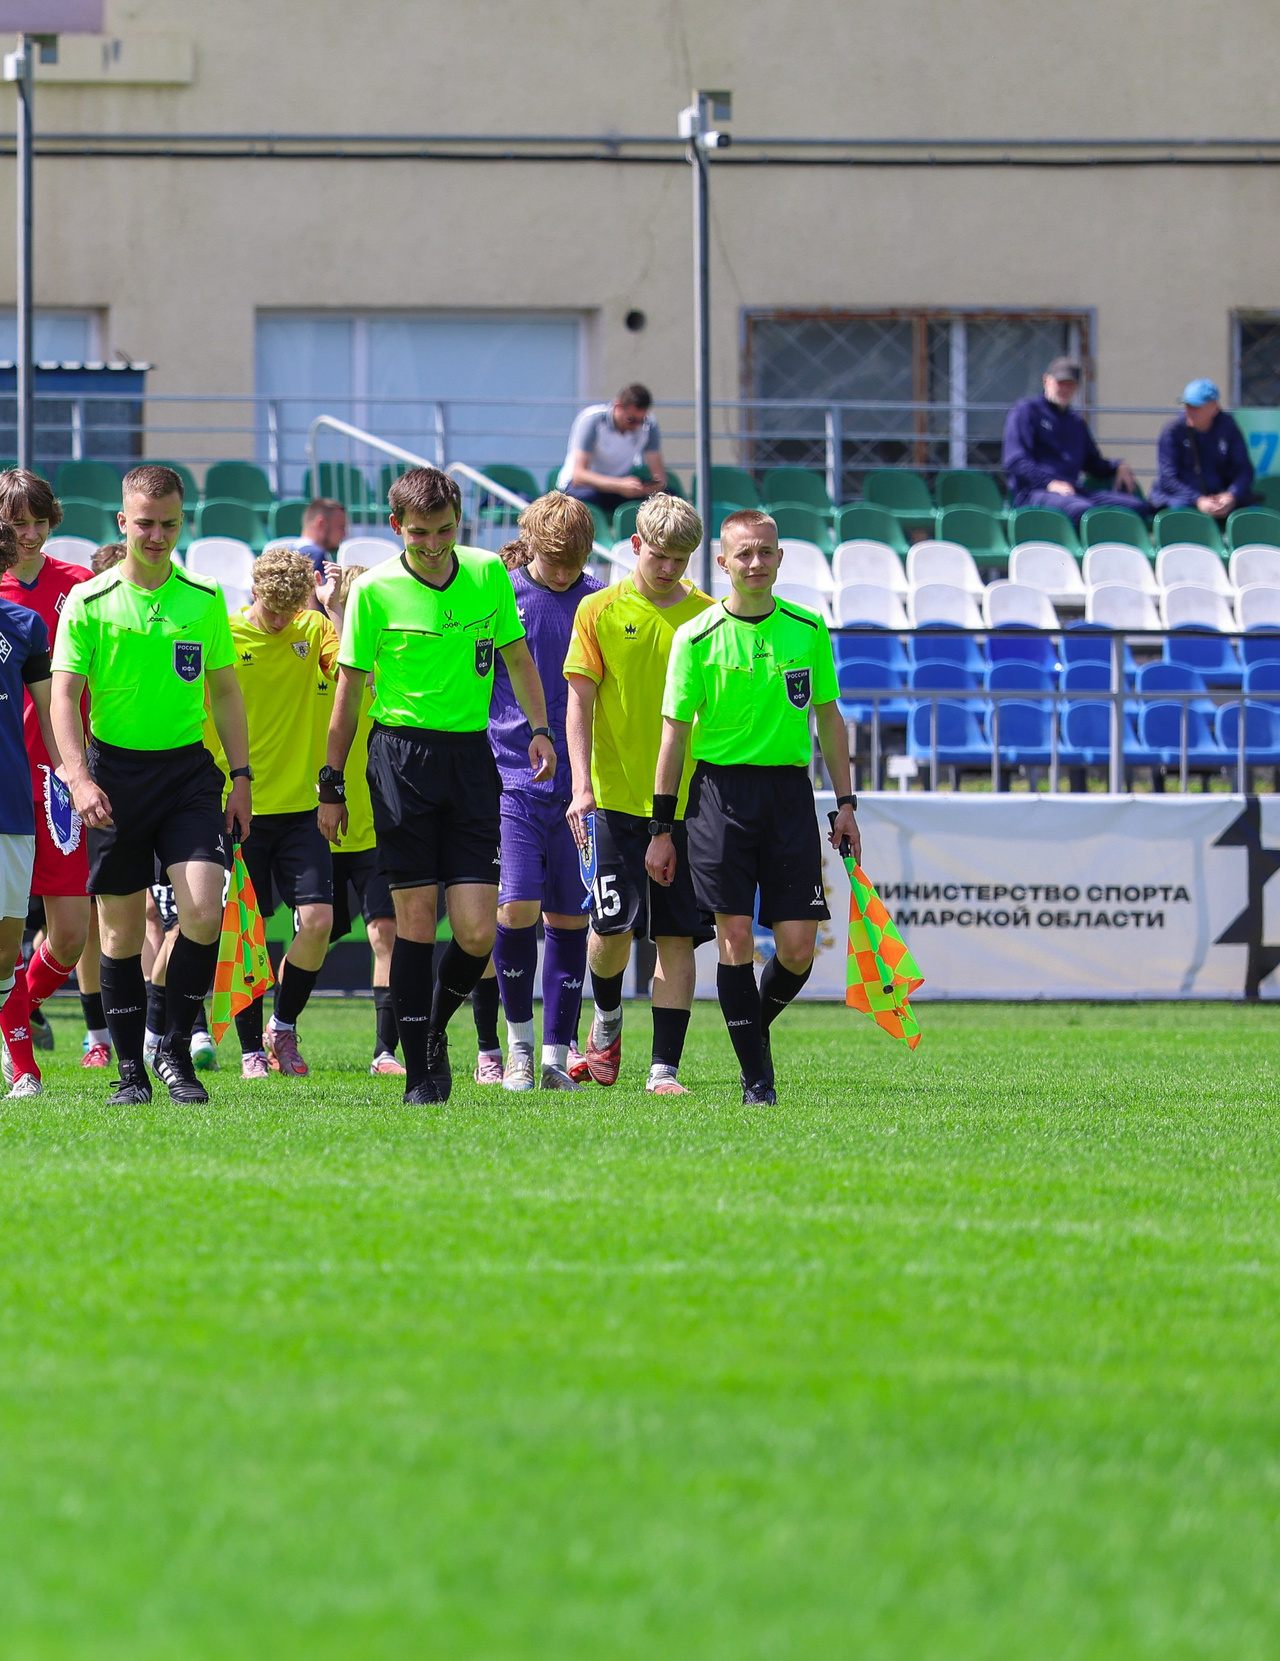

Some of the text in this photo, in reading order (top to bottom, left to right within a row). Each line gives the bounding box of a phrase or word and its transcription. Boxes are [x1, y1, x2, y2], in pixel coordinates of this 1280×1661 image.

[1249, 431, 1279, 474] 7
[786, 671, 808, 680] РОССИЯ
[593, 874, 621, 920] 15
[1086, 884, 1191, 902] СПОРТА
[1036, 911, 1165, 928] ОБЛАСТИ
